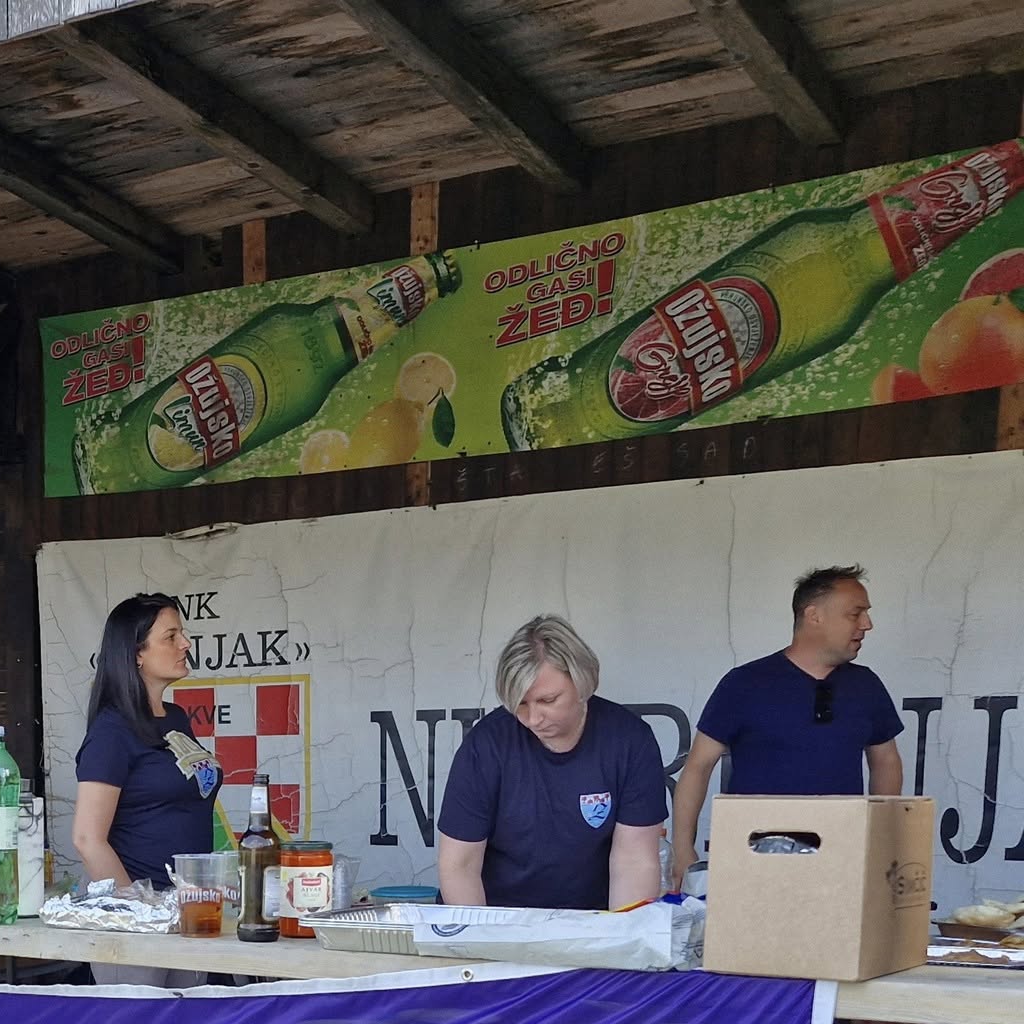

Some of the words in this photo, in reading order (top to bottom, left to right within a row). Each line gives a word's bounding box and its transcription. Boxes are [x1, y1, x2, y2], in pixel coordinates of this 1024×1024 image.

[483, 231, 626, 293] ODLIČNO
[526, 266, 594, 303] GASI
[495, 258, 617, 348] ŽEĐ!
[50, 311, 152, 360] ODLIČNO
[62, 335, 146, 406] ŽEĐ!
